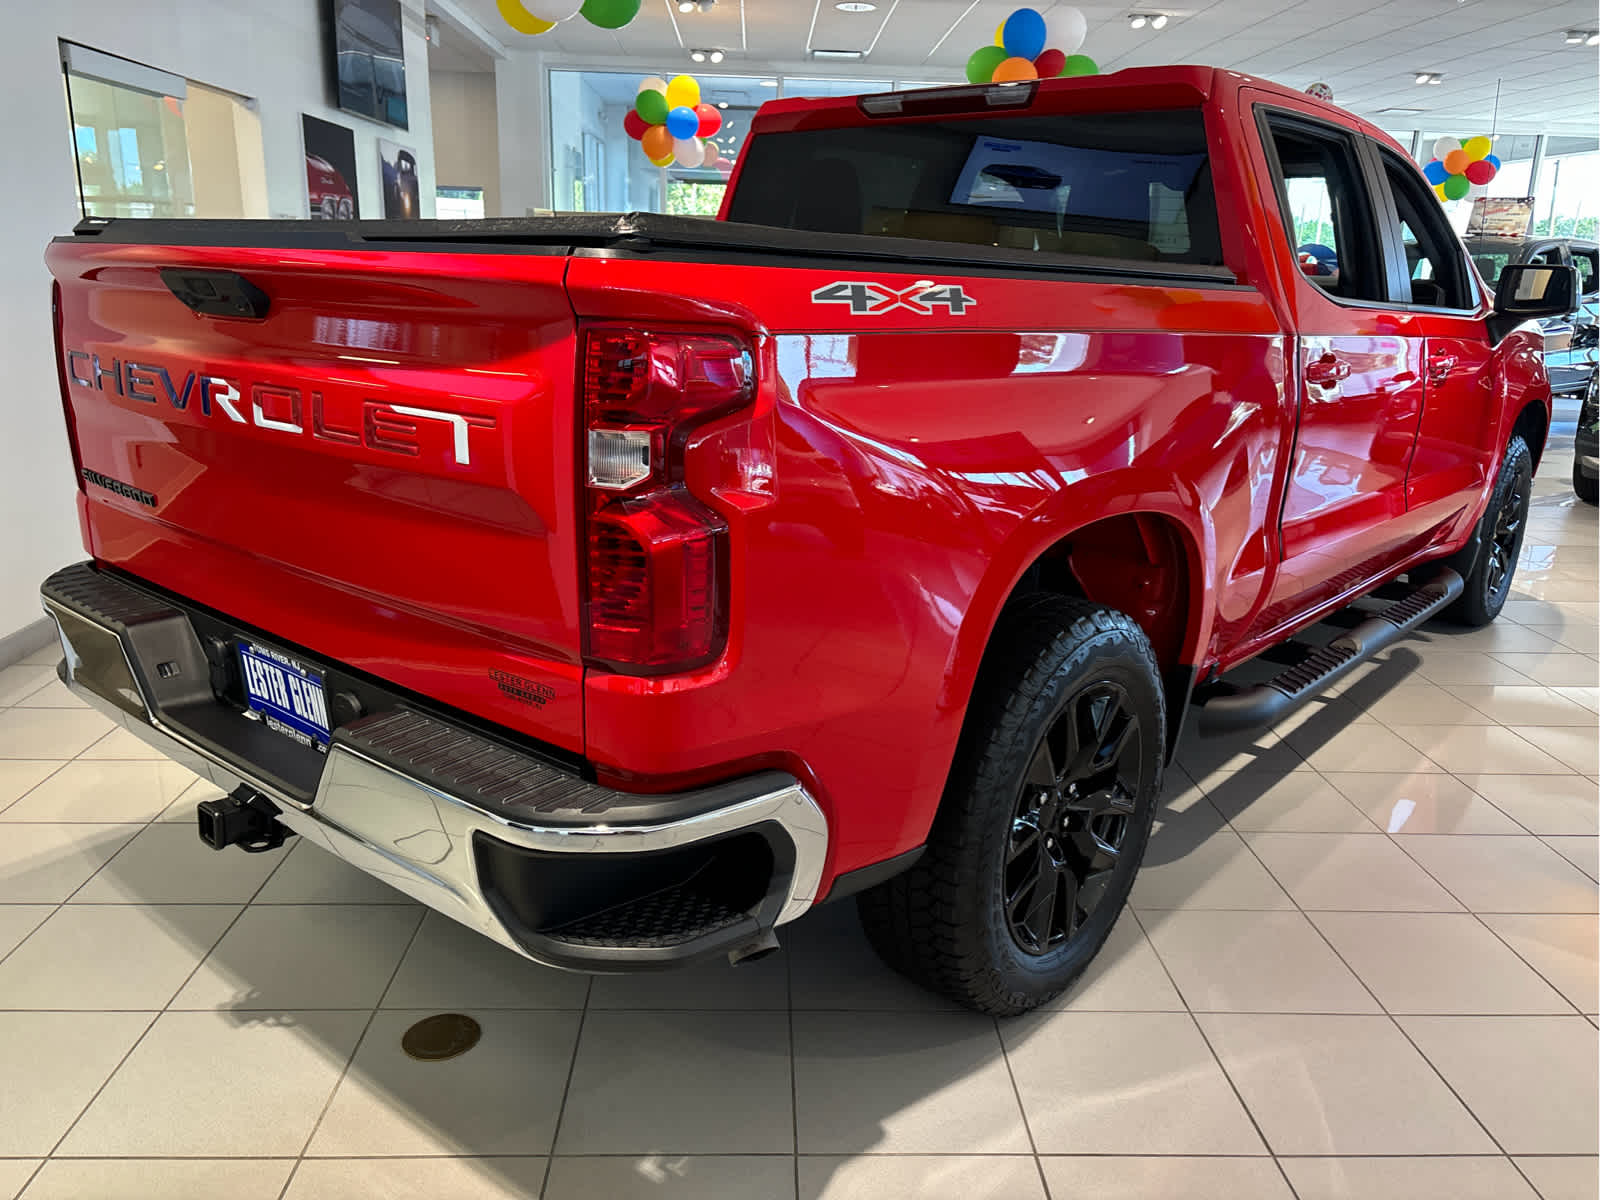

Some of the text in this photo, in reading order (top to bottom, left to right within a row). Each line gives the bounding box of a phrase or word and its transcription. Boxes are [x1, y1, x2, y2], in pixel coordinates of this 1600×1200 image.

[68, 350, 496, 465] CHEVROLET
[81, 468, 156, 507] SILVERADO
[242, 654, 330, 731] LESTER GLENN
[488, 667, 522, 688] LESTER
[523, 679, 556, 701] GLENN
